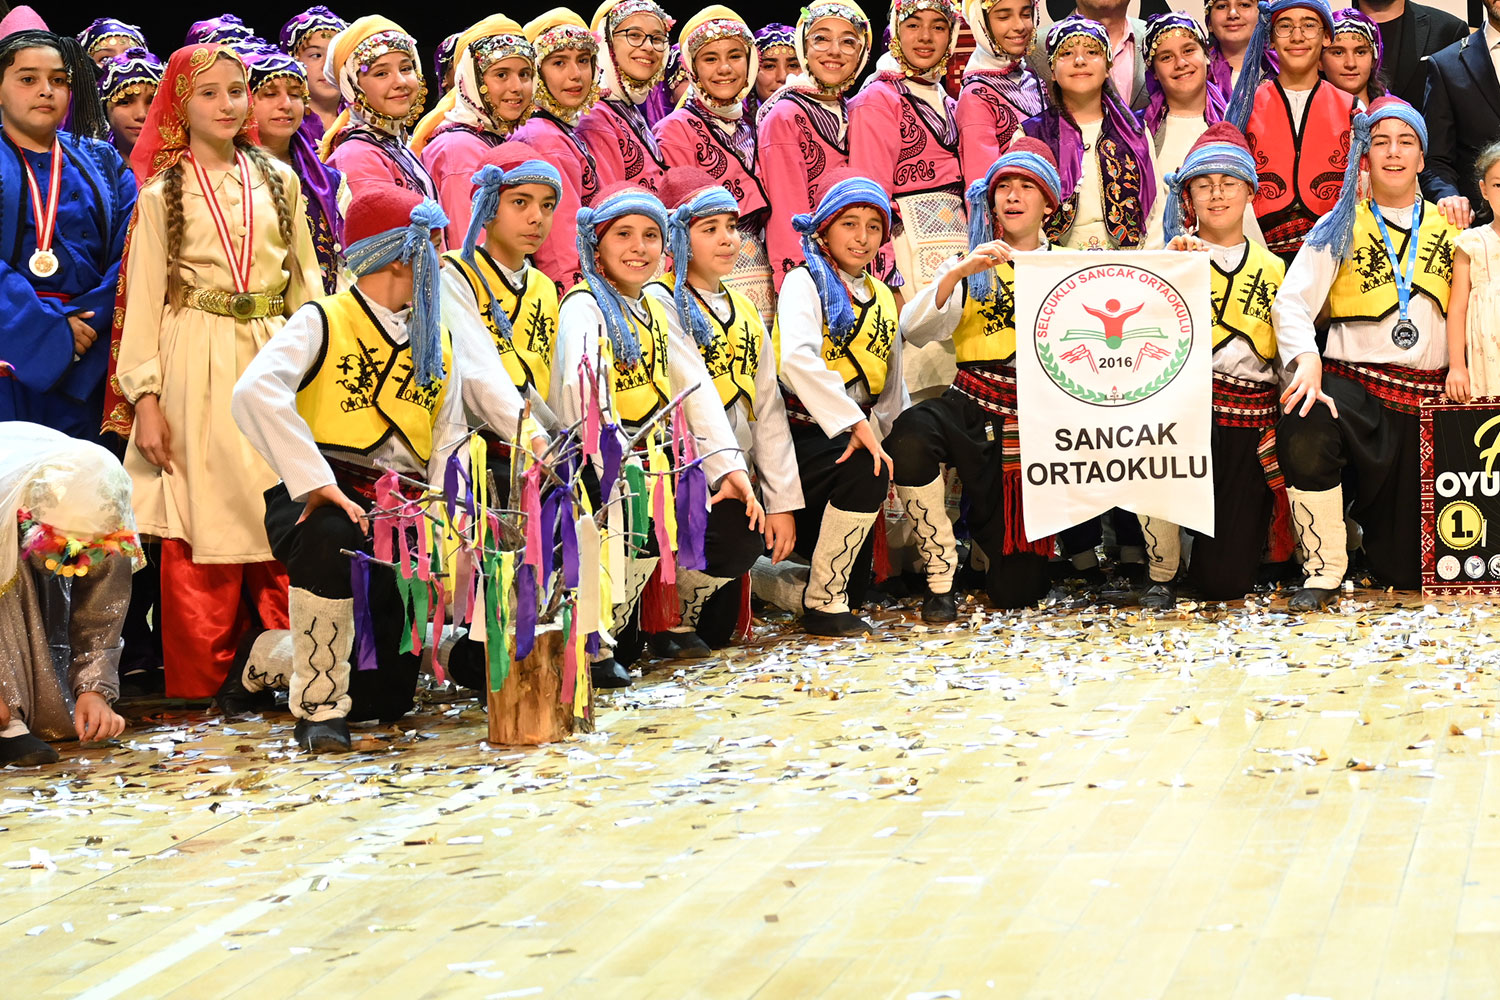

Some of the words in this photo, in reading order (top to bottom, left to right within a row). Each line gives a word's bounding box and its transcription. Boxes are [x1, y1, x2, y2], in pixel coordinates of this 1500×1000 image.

[1037, 279, 1077, 338] SELÇUKLU
[1078, 267, 1136, 284] SANCAK
[1138, 273, 1191, 333] ORTAOKULU
[1098, 356, 1133, 369] 2016
[1054, 422, 1178, 451] SANCAK
[1026, 455, 1208, 486] ORTAOKULU
[1451, 510, 1473, 538] 1.
